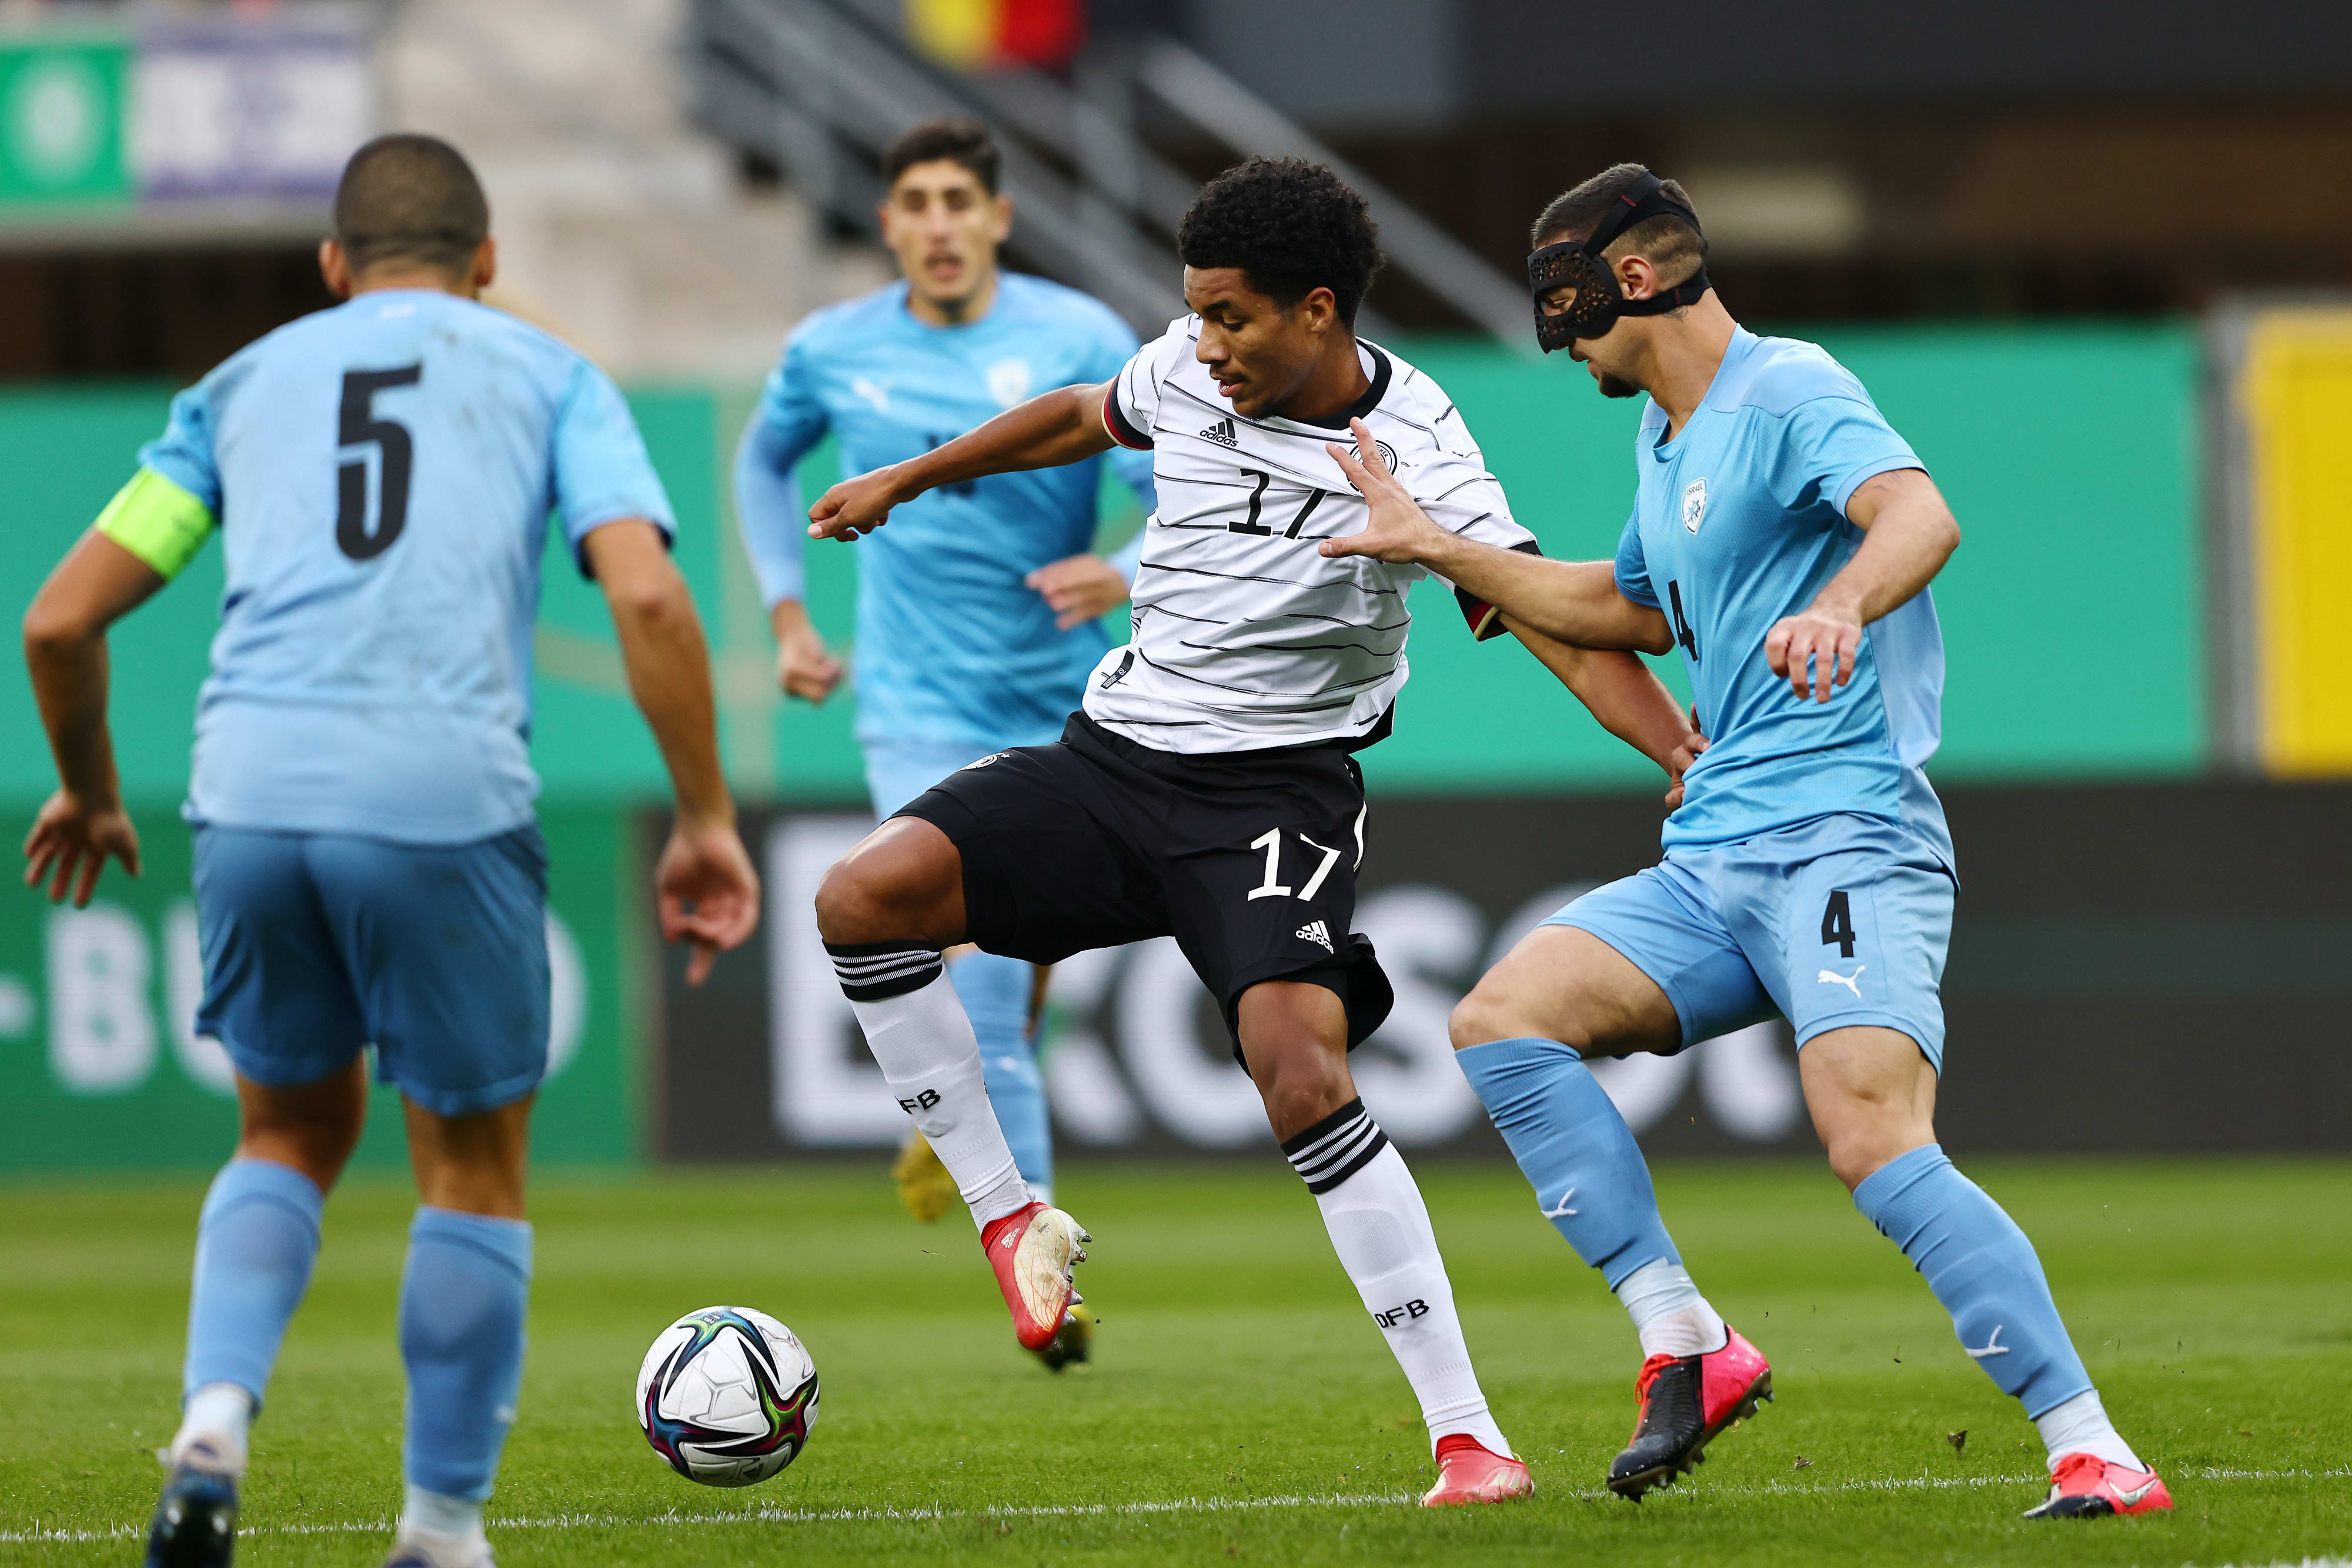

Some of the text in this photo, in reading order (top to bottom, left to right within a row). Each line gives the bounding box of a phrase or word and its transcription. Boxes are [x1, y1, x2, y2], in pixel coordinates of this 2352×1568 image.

[1200, 430, 1238, 447] adidas
[336, 362, 422, 561] 5
[1687, 483, 1703, 495] ISRAEL
[1668, 579, 1699, 661] 4
[1247, 827, 1341, 902] 17
[1821, 890, 1856, 958] 4
[1295, 930, 1334, 954] adidas
[895, 1089, 941, 1114] FB
[1374, 1299, 1429, 1328] DFB
